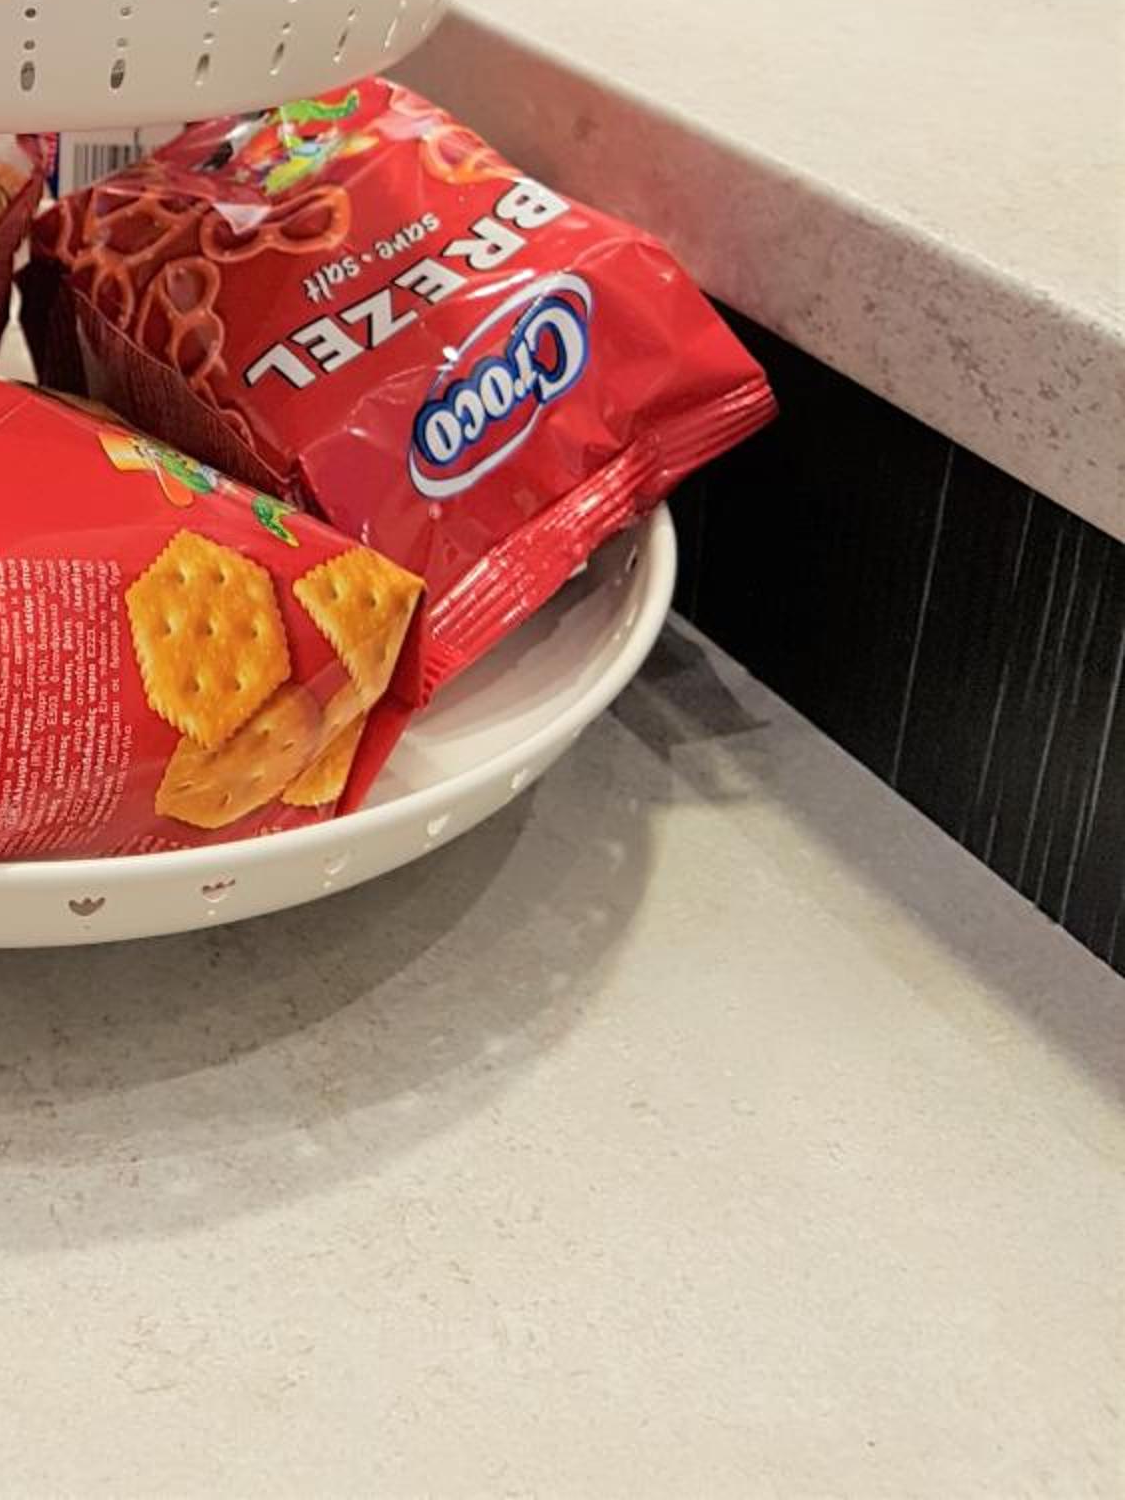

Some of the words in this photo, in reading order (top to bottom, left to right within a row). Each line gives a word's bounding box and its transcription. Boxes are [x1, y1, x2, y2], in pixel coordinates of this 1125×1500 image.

[245, 182, 572, 389] BREZEL
[303, 258, 363, 304] salt
[374, 212, 442, 257] sare
[420, 302, 587, 466] Croco
